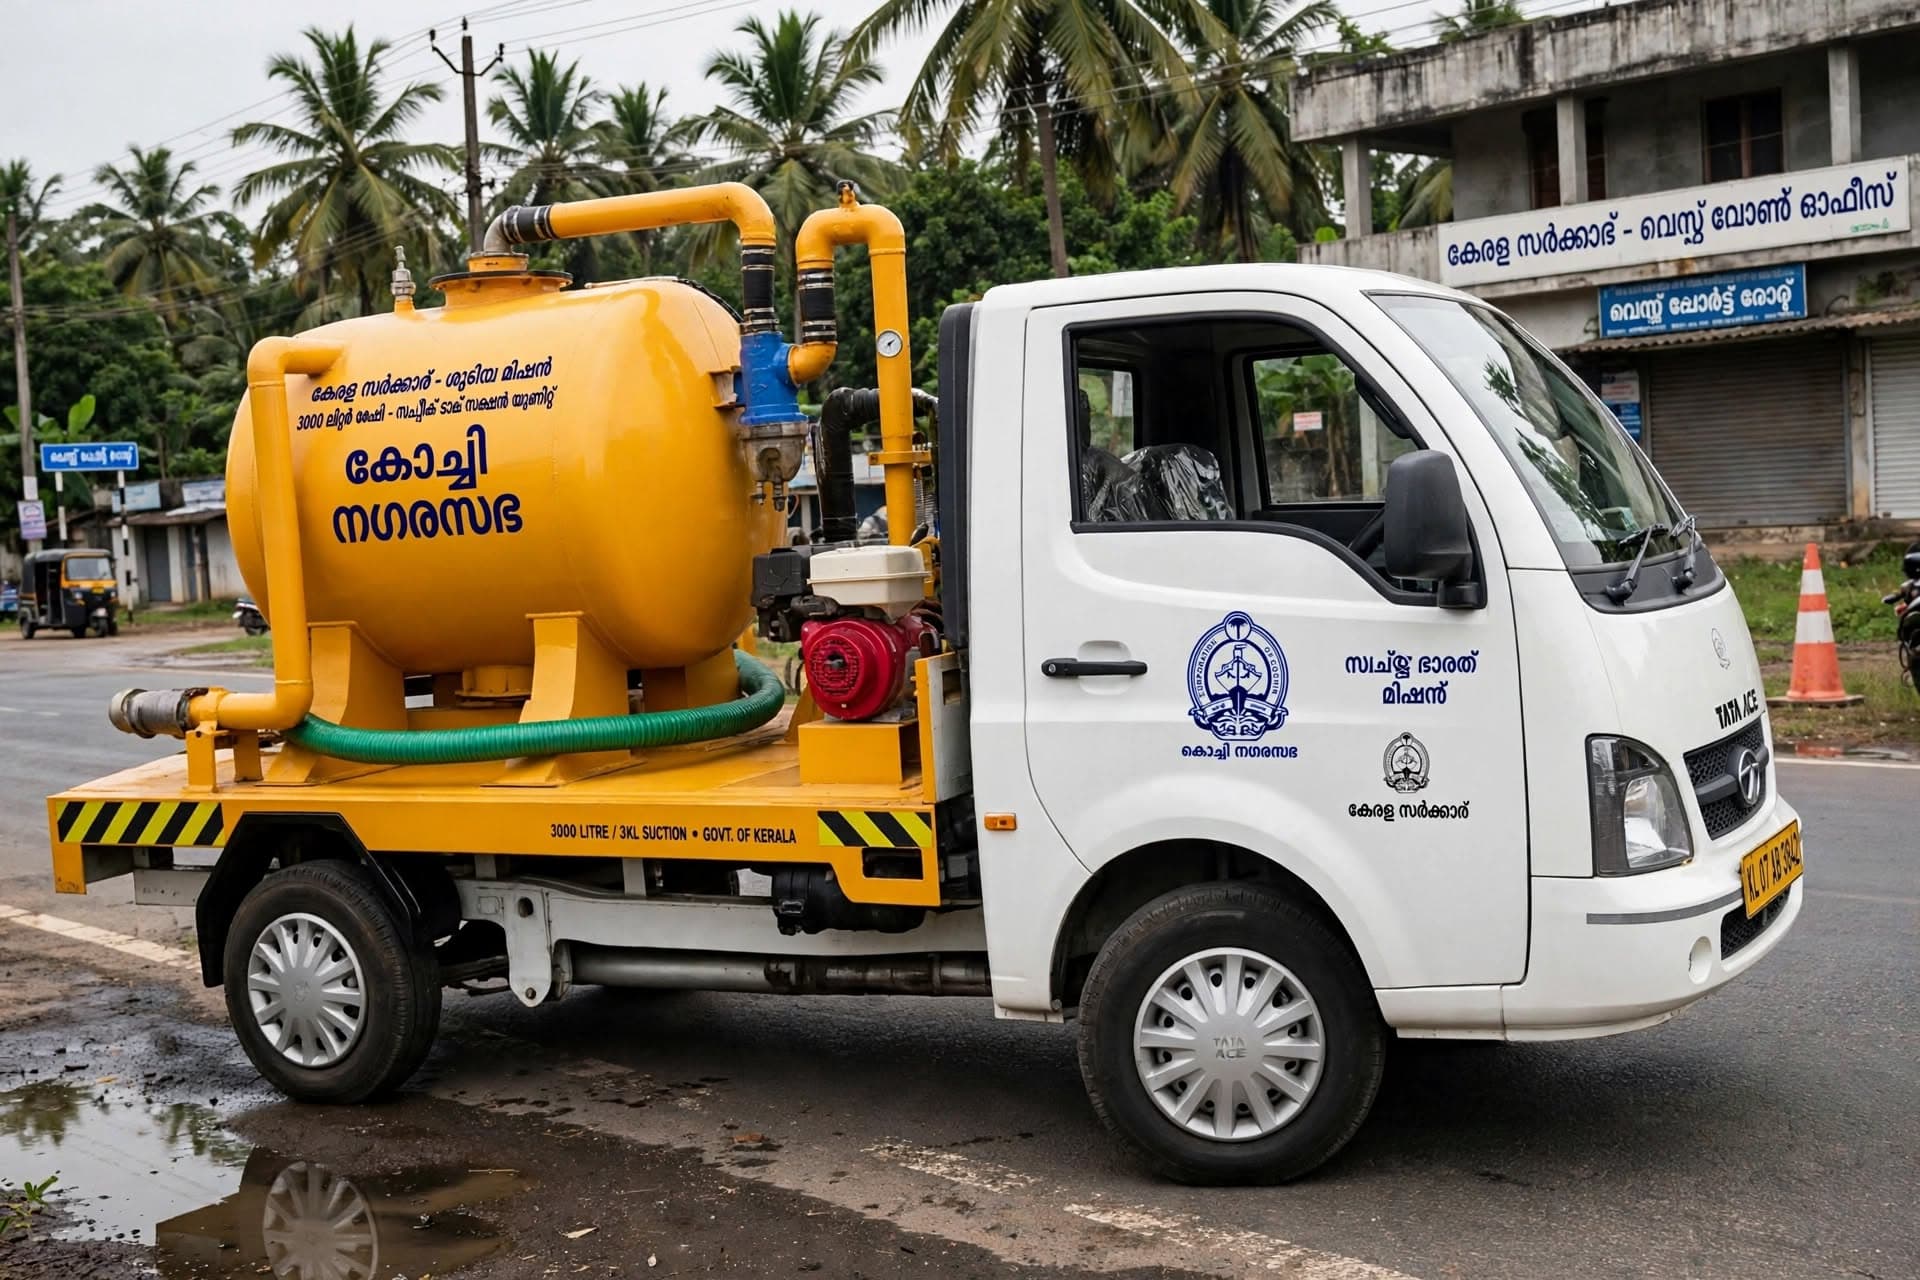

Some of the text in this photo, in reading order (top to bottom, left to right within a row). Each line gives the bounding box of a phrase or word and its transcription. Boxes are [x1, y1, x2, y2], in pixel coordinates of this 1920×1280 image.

[1448, 237, 1510, 267] കേരള
[1800, 171, 1897, 218] ഓഫീസ്
[312, 382, 357, 403] കേരള
[296, 413, 324, 431] 3000
[345, 424, 488, 490] കോച്ചി
[333, 493, 523, 543] നഗരസഭ
[1418, 650, 1479, 674] ഭാരത്
[1714, 688, 1759, 730] TATA ACE
[1235, 745, 1298, 759] നഗരസഭ
[1348, 803, 1395, 822] കേരള
[550, 823, 577, 838] 3000
[580, 824, 609, 839] LITRE
[619, 825, 640, 840] 3KL
[642, 826, 687, 841] SUCTION
[703, 826, 734, 842] GOVT.
[737, 827, 751, 842] OF
[754, 828, 797, 844] KERALA
[1759, 853, 1770, 893] 07
